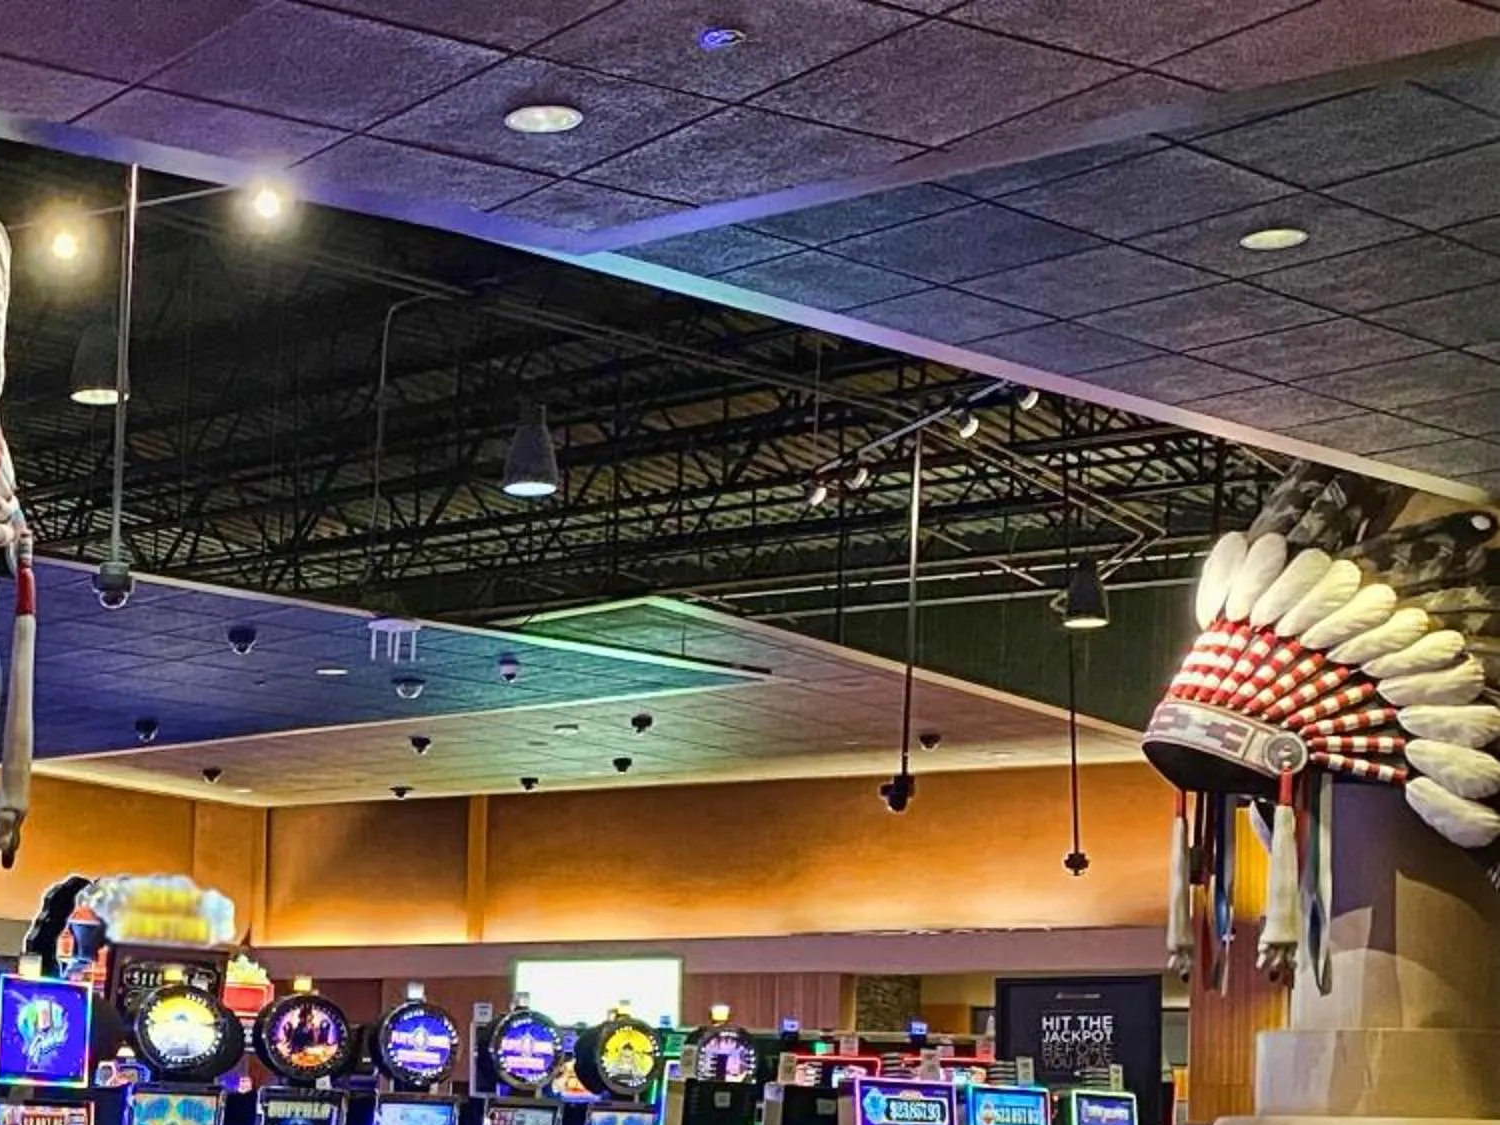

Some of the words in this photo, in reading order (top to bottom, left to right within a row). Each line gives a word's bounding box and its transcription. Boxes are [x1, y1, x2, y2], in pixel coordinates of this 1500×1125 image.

[1042, 1015, 1072, 1031] HIT
[1077, 1015, 1113, 1031] THE
[1042, 1030, 1114, 1043] JACKPOT
[1042, 1043, 1113, 1056] BEFORE
[1043, 1056, 1073, 1068] YOU
